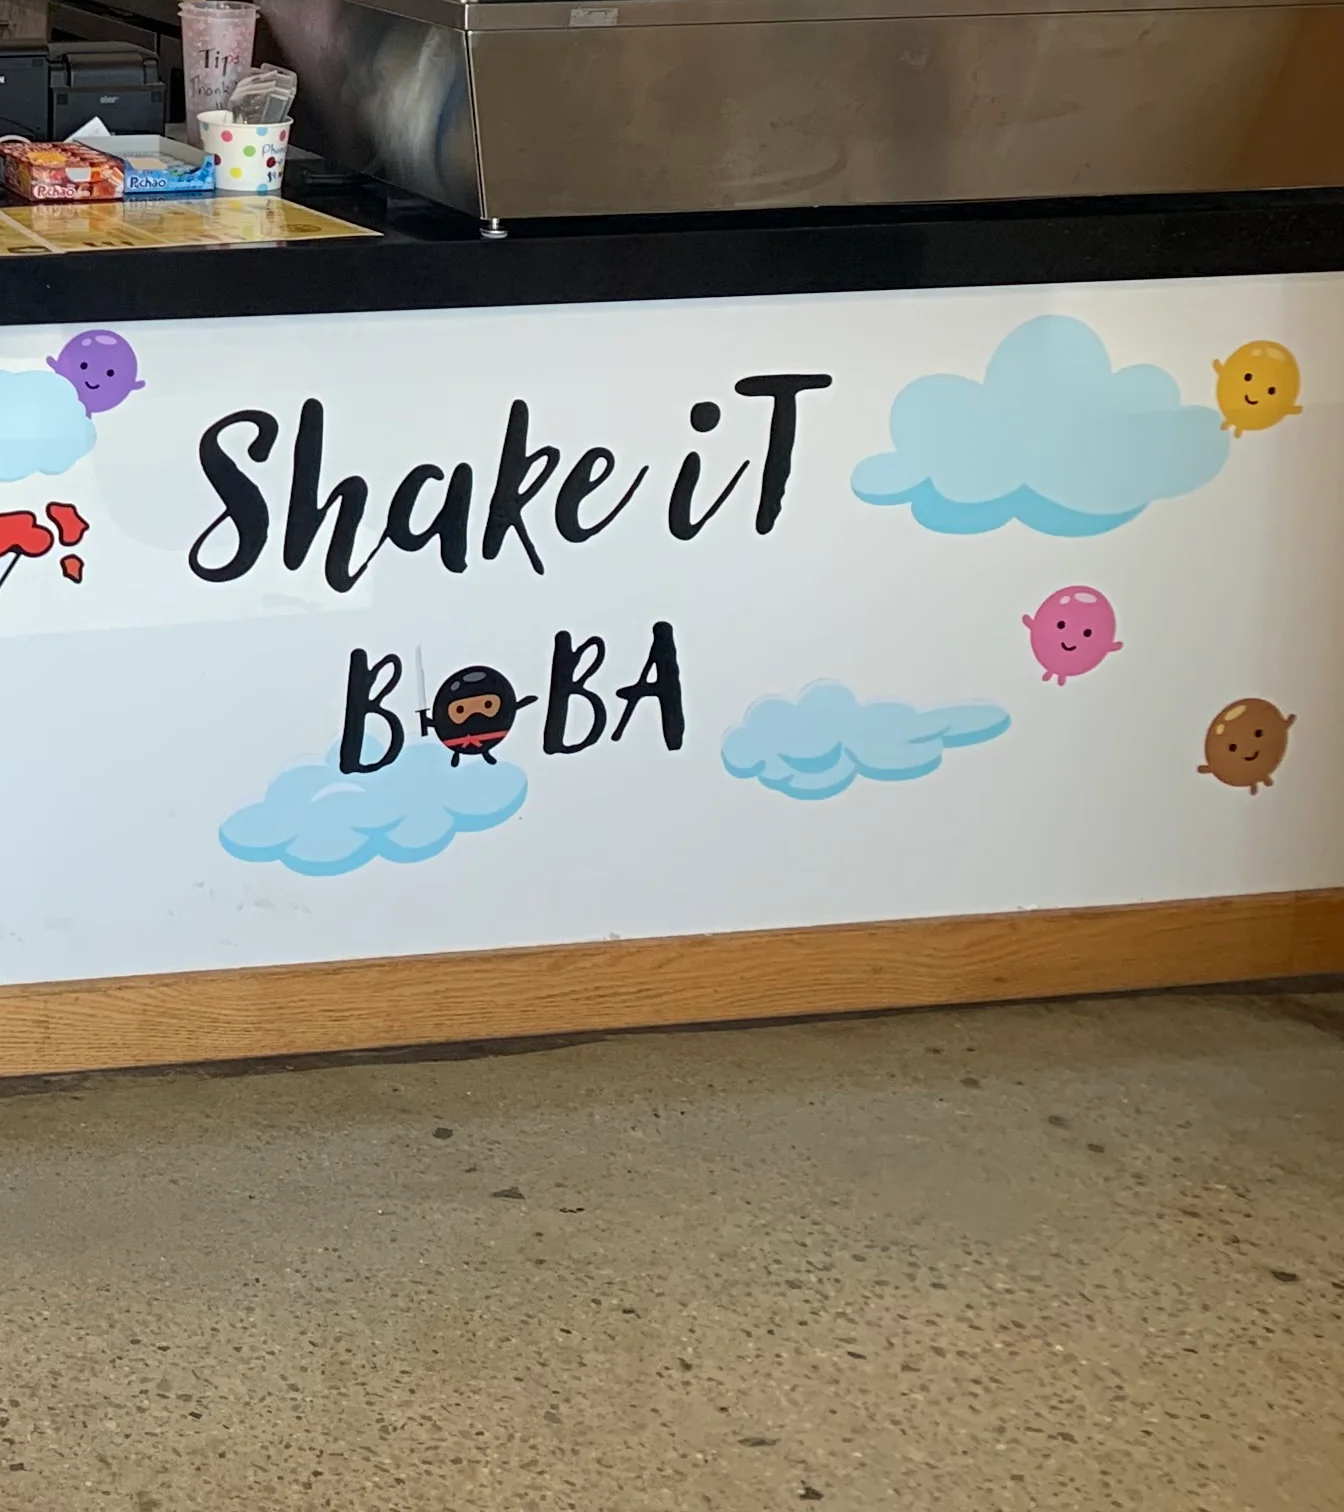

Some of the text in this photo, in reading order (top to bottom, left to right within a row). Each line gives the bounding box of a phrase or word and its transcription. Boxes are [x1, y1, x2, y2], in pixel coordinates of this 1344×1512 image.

[198, 48, 241, 77] Tips
[188, 373, 833, 593] Shake iT
